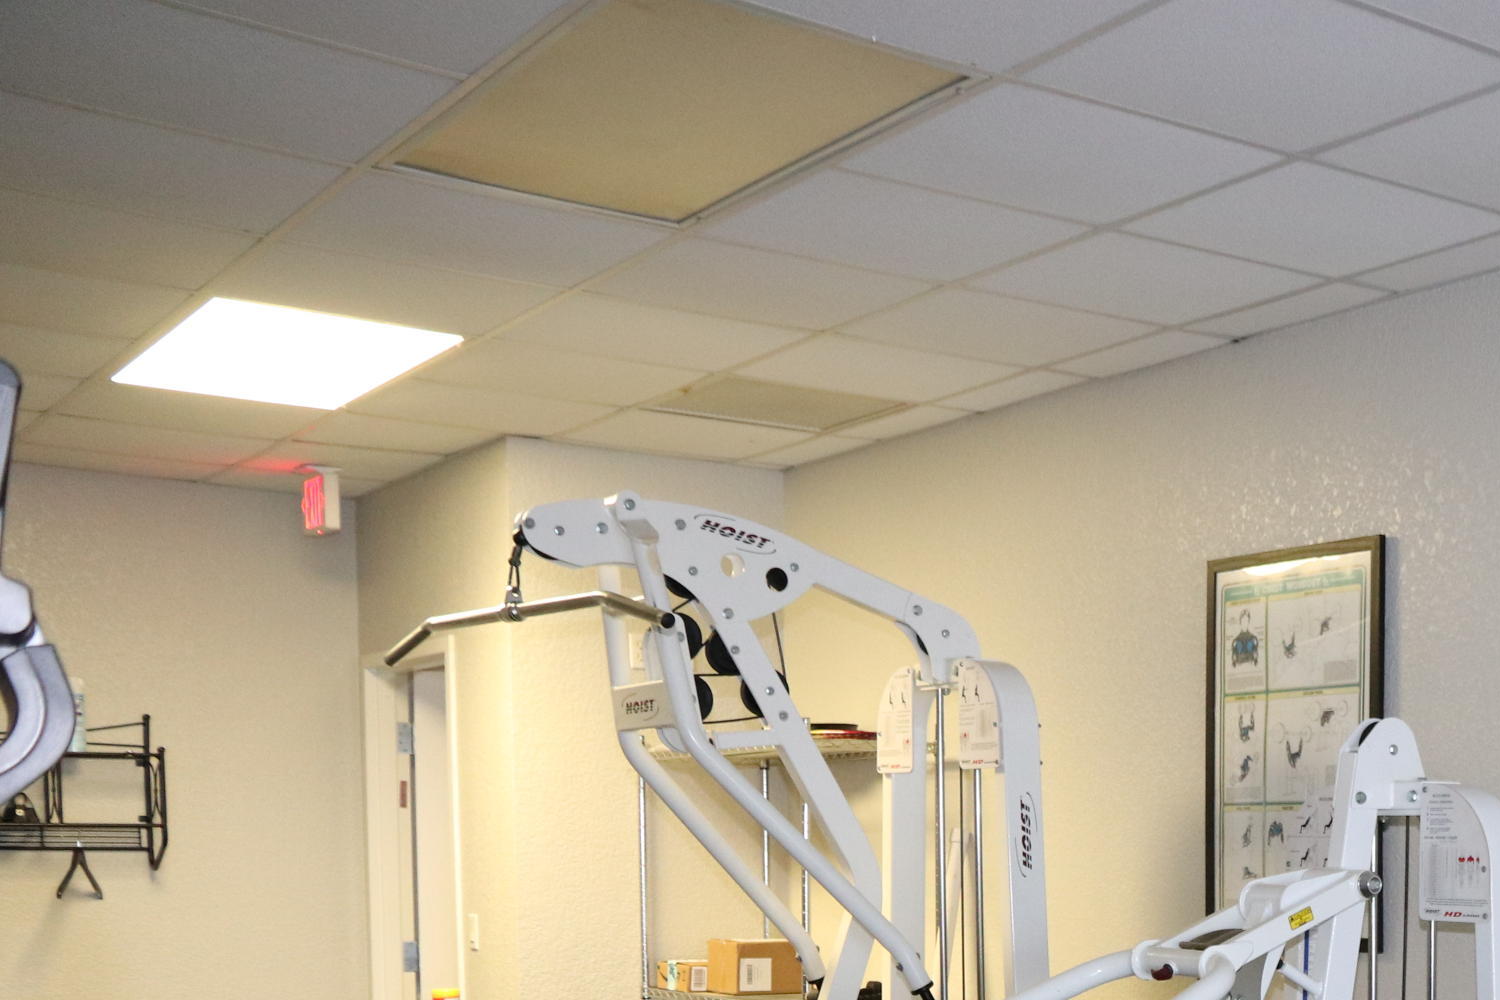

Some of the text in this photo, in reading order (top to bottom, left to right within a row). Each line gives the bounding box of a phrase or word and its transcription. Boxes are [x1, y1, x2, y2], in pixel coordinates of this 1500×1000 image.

[700, 519, 770, 548] HOIST
[625, 699, 655, 715] HOIST
[1020, 799, 1033, 870] HOIST
